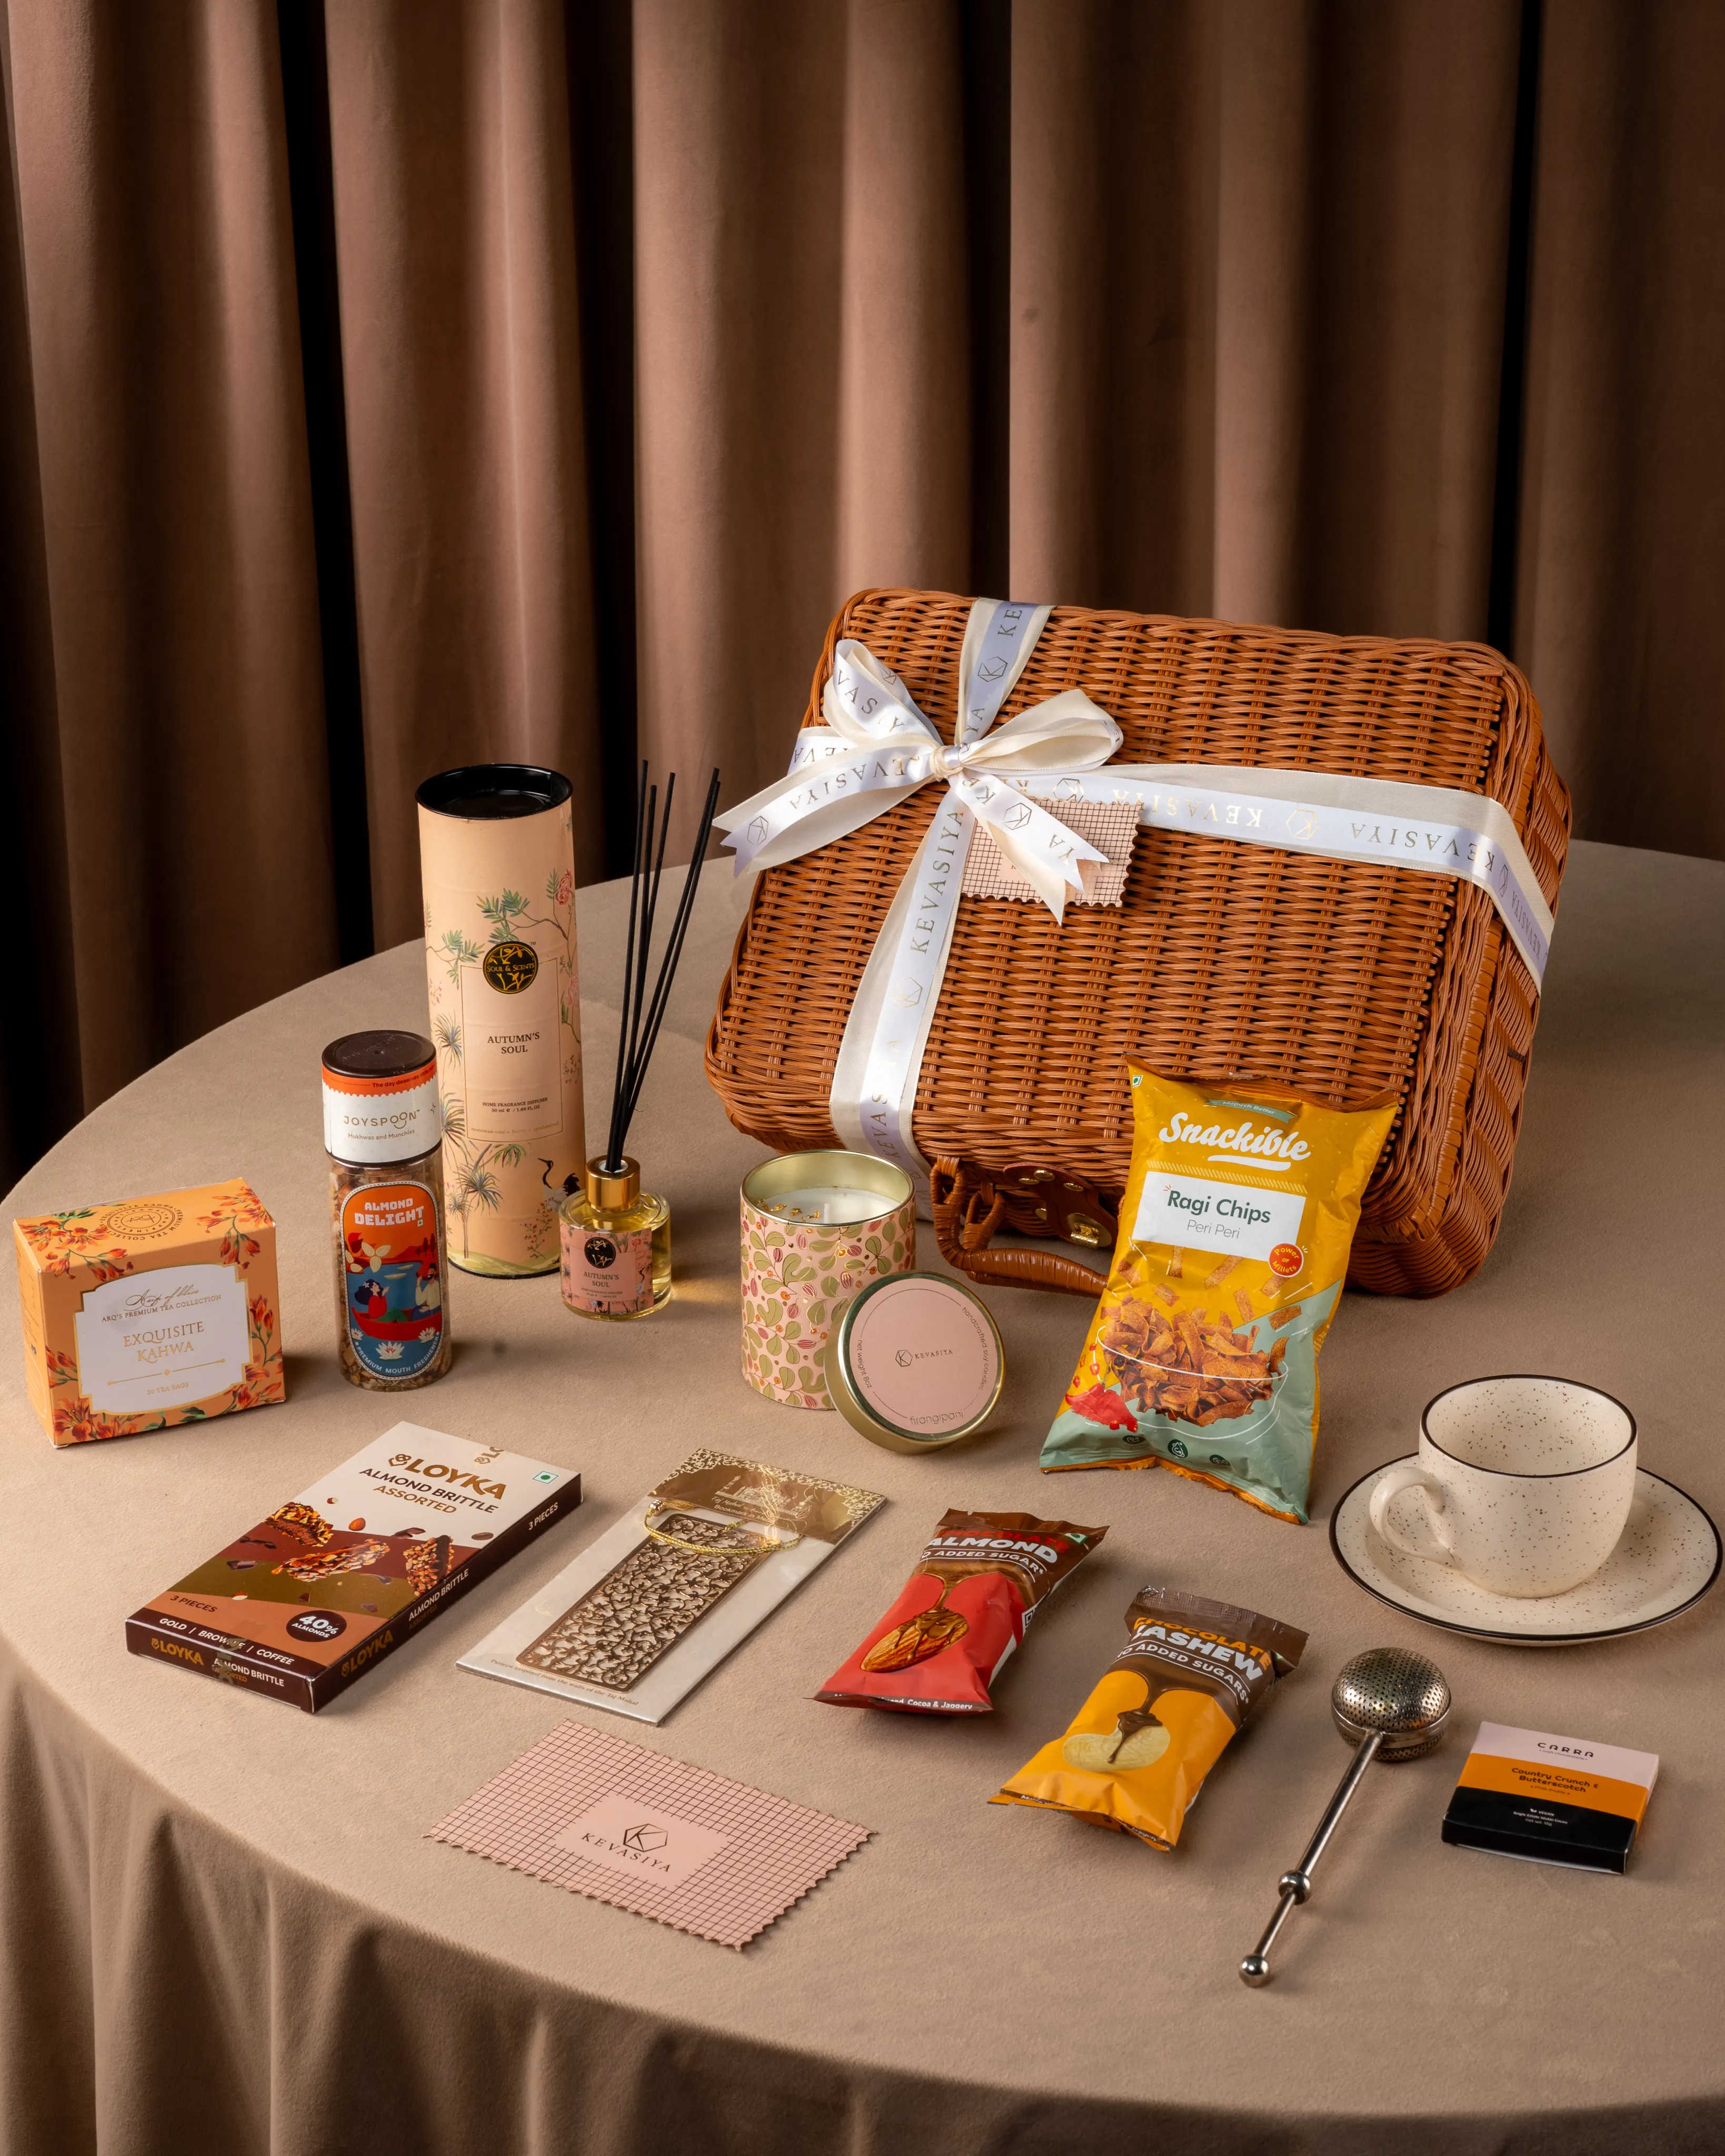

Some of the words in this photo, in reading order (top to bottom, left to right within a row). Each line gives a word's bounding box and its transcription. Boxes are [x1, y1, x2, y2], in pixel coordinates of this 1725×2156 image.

[790, 756, 920, 810] EVASIYA
[1351, 822, 1496, 872] KEVASIYA
[910, 812, 964, 955] KEVASIYA
[487, 1032, 540, 1044] AUTUMN'S
[501, 1045, 528, 1054] SOUL
[396, 1075, 420, 1085] deserves
[527, 1097, 549, 1105] DIFFUSER
[1253, 1105, 1277, 1115] Better
[388, 1129, 415, 1140] Munchies
[1158, 1112, 1312, 1162] Snackible
[364, 1197, 414, 1211] ALMOND
[1166, 1190, 1211, 1216] Ragi
[1215, 1198, 1272, 1225] Chips
[354, 1206, 424, 1226] DELIGHT
[1186, 1219, 1213, 1236] Peri
[1215, 1222, 1241, 1240] Peri
[1274, 1247, 1300, 1259] Power
[583, 1271, 620, 1281] AUTUMN'S
[1272, 1261, 1297, 1273] Millets
[102, 1313, 123, 1323] ARQ'S
[125, 1306, 158, 1319] PREMIUM
[176, 1294, 222, 1309] COLLECTION
[123, 1321, 205, 1348] EXQUISITE
[137, 1341, 195, 1364] KAHWA
[357, 1346, 383, 1372] PREMIUM
[385, 1366, 411, 1374] MOUTH
[413, 1335, 440, 1370] FRESHENER
[914, 1349, 954, 1360] KEVASIYA
[962, 1306, 988, 1348] handcrafted
[978, 1363, 989, 1391] candles
[857, 1352, 866, 1377] weight
[171, 1381, 190, 1391] BAGS
[404, 1458, 507, 1500] LOYKA
[358, 1468, 432, 1493] ALMOND
[431, 1488, 499, 1514] BRITTLE
[373, 1485, 457, 1514] ASSORTED
[528, 1521, 534, 1531] 3
[534, 1501, 559, 1527] PIECES
[714, 1504, 750, 1518] Bookmark
[927, 1537, 1058, 1563] ALMOND
[178, 1597, 218, 1613] PIECES
[408, 1592, 440, 1622] ALMOND
[440, 1568, 469, 1597] BRITTLE
[298, 1615, 340, 1635] 40%
[408, 1603, 438, 1630] ASSORTED
[291, 1622, 331, 1639] ALMONDS
[159, 1618, 187, 1631] GOLD
[198, 1630, 246, 1650] BROWE
[256, 1649, 295, 1665] COFFEE
[350, 1630, 394, 1673] LOYKA
[159, 1640, 204, 1666] LOYKA
[1135, 1643, 1189, 1663] ADDED
[251, 1669, 285, 1687] BRITTLE
[490, 1659, 513, 1669] Pattern
[514, 1665, 541, 1679] inspired
[540, 1672, 556, 1681] from
[569, 1682, 586, 1690] walls
[607, 1692, 617, 1702] Taj
[617, 1695, 640, 1706] Mahal
[907, 1699, 931, 1708] Cocoa
[1537, 1742, 1594, 1758] CARRA
[1511, 1768, 1552, 1780] Country
[1554, 1775, 1590, 1788] Crunch
[1519, 1775, 1587, 1793] Butterscotch
[580, 1832, 672, 1873] KEVASIYA
